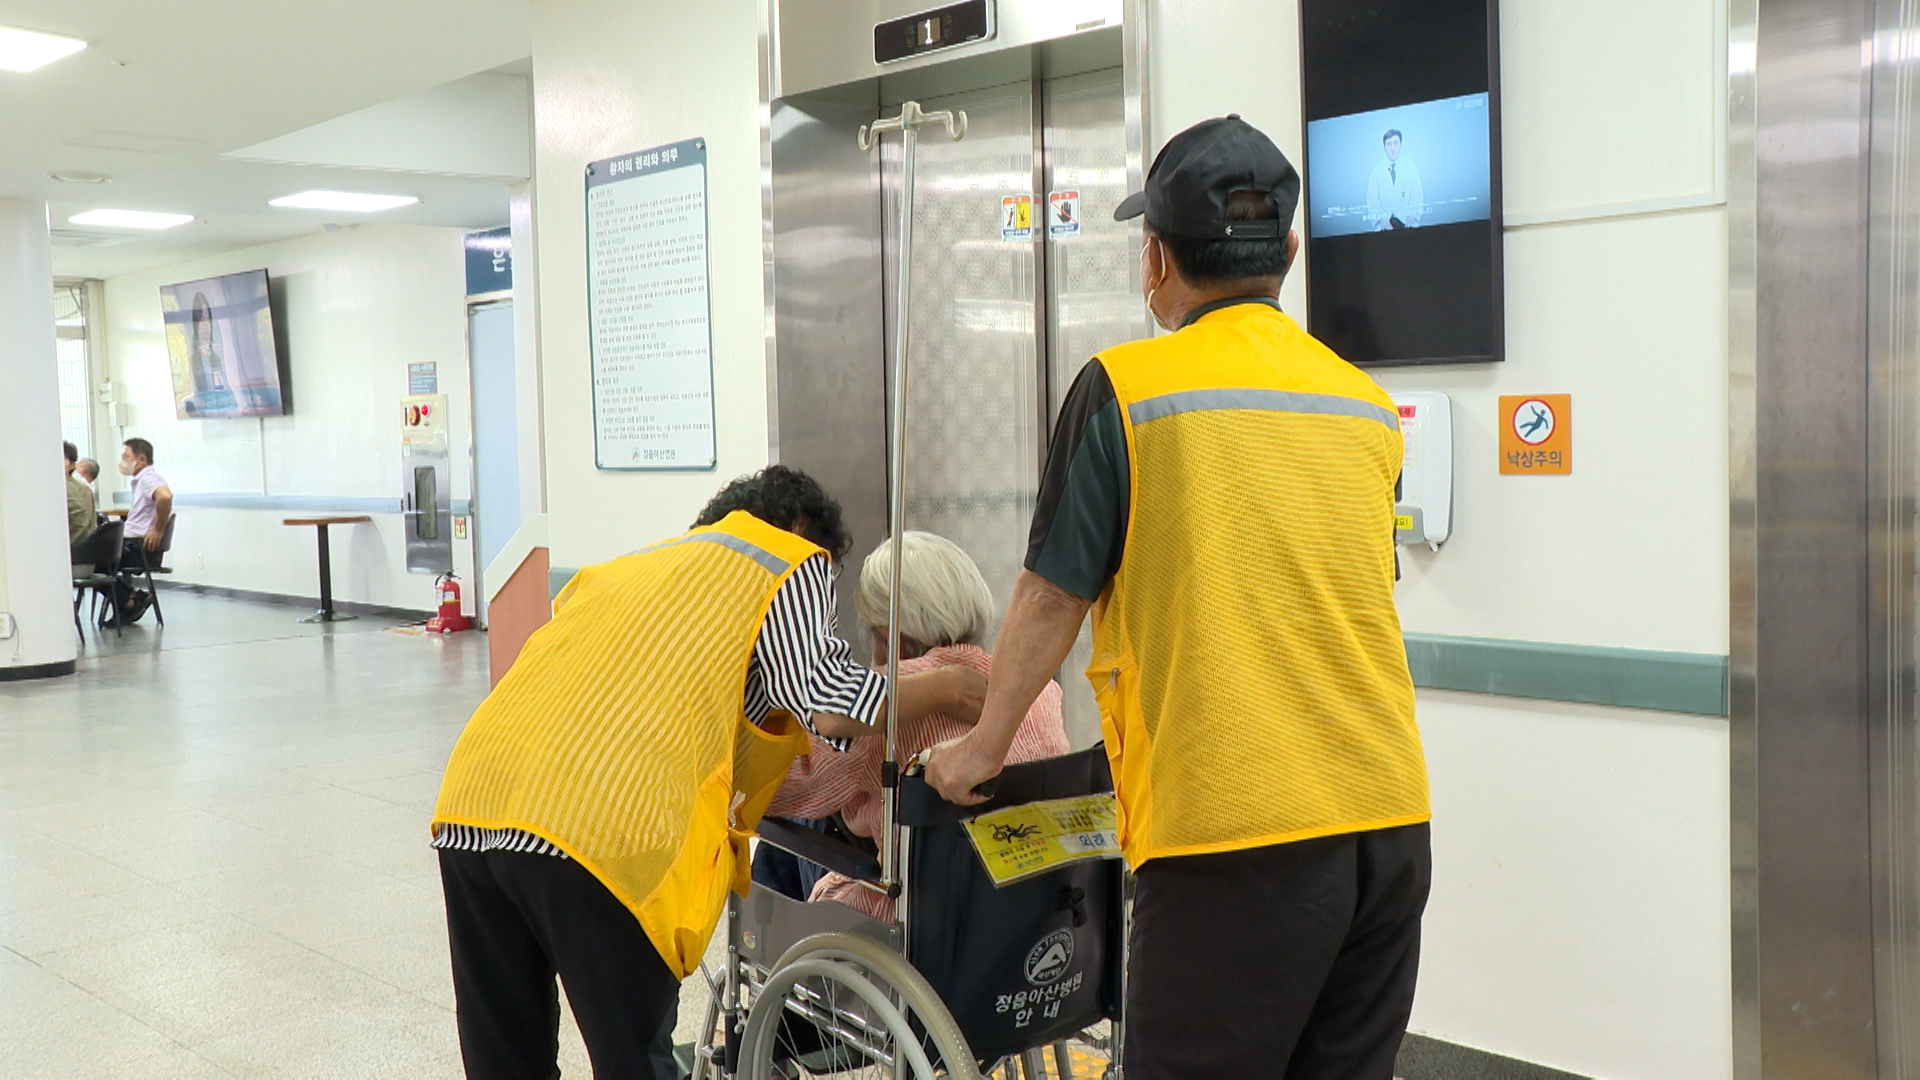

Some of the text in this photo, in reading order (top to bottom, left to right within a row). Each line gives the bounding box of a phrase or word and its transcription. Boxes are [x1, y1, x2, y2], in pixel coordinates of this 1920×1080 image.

[925, 19, 933, 45] 1
[610, 147, 679, 176] 환자의 권리와 의무
[492, 248, 512, 272] 은
[1507, 450, 1562, 468] 낙상주의
[995, 971, 1083, 1013] 정읍아산병원
